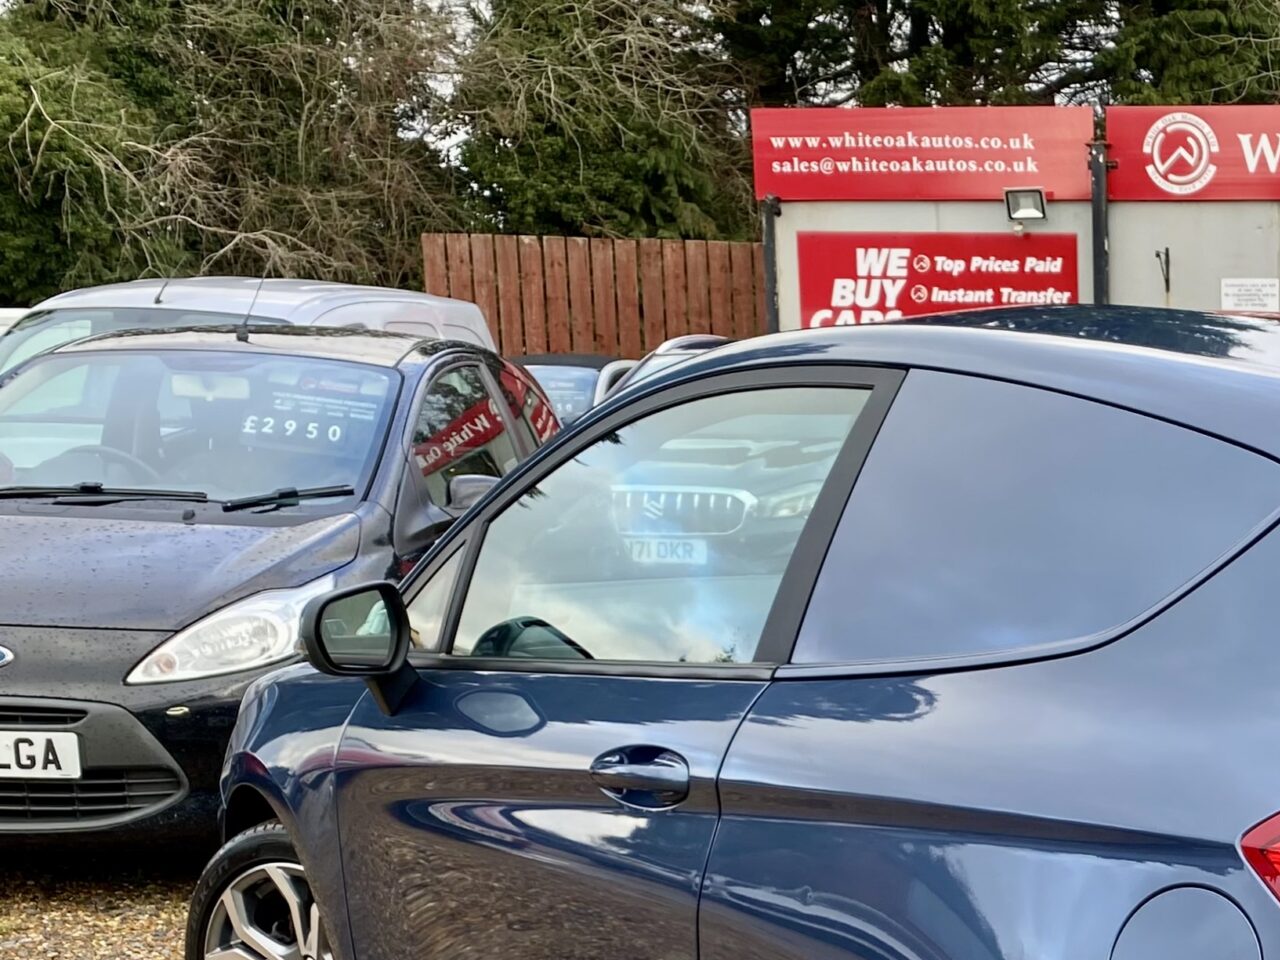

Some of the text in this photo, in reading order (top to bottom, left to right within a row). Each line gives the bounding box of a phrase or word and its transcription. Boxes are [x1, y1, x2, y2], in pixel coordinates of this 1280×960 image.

[770, 131, 1035, 150] www.whiteoakautos.co.uk
[771, 156, 1039, 175] sales@whiteoakautos.co.uk
[856, 248, 911, 277] WE
[934, 256, 1063, 276] Top Prices Paid
[831, 278, 907, 308] BUY
[931, 286, 1071, 305] Instant Transfer
